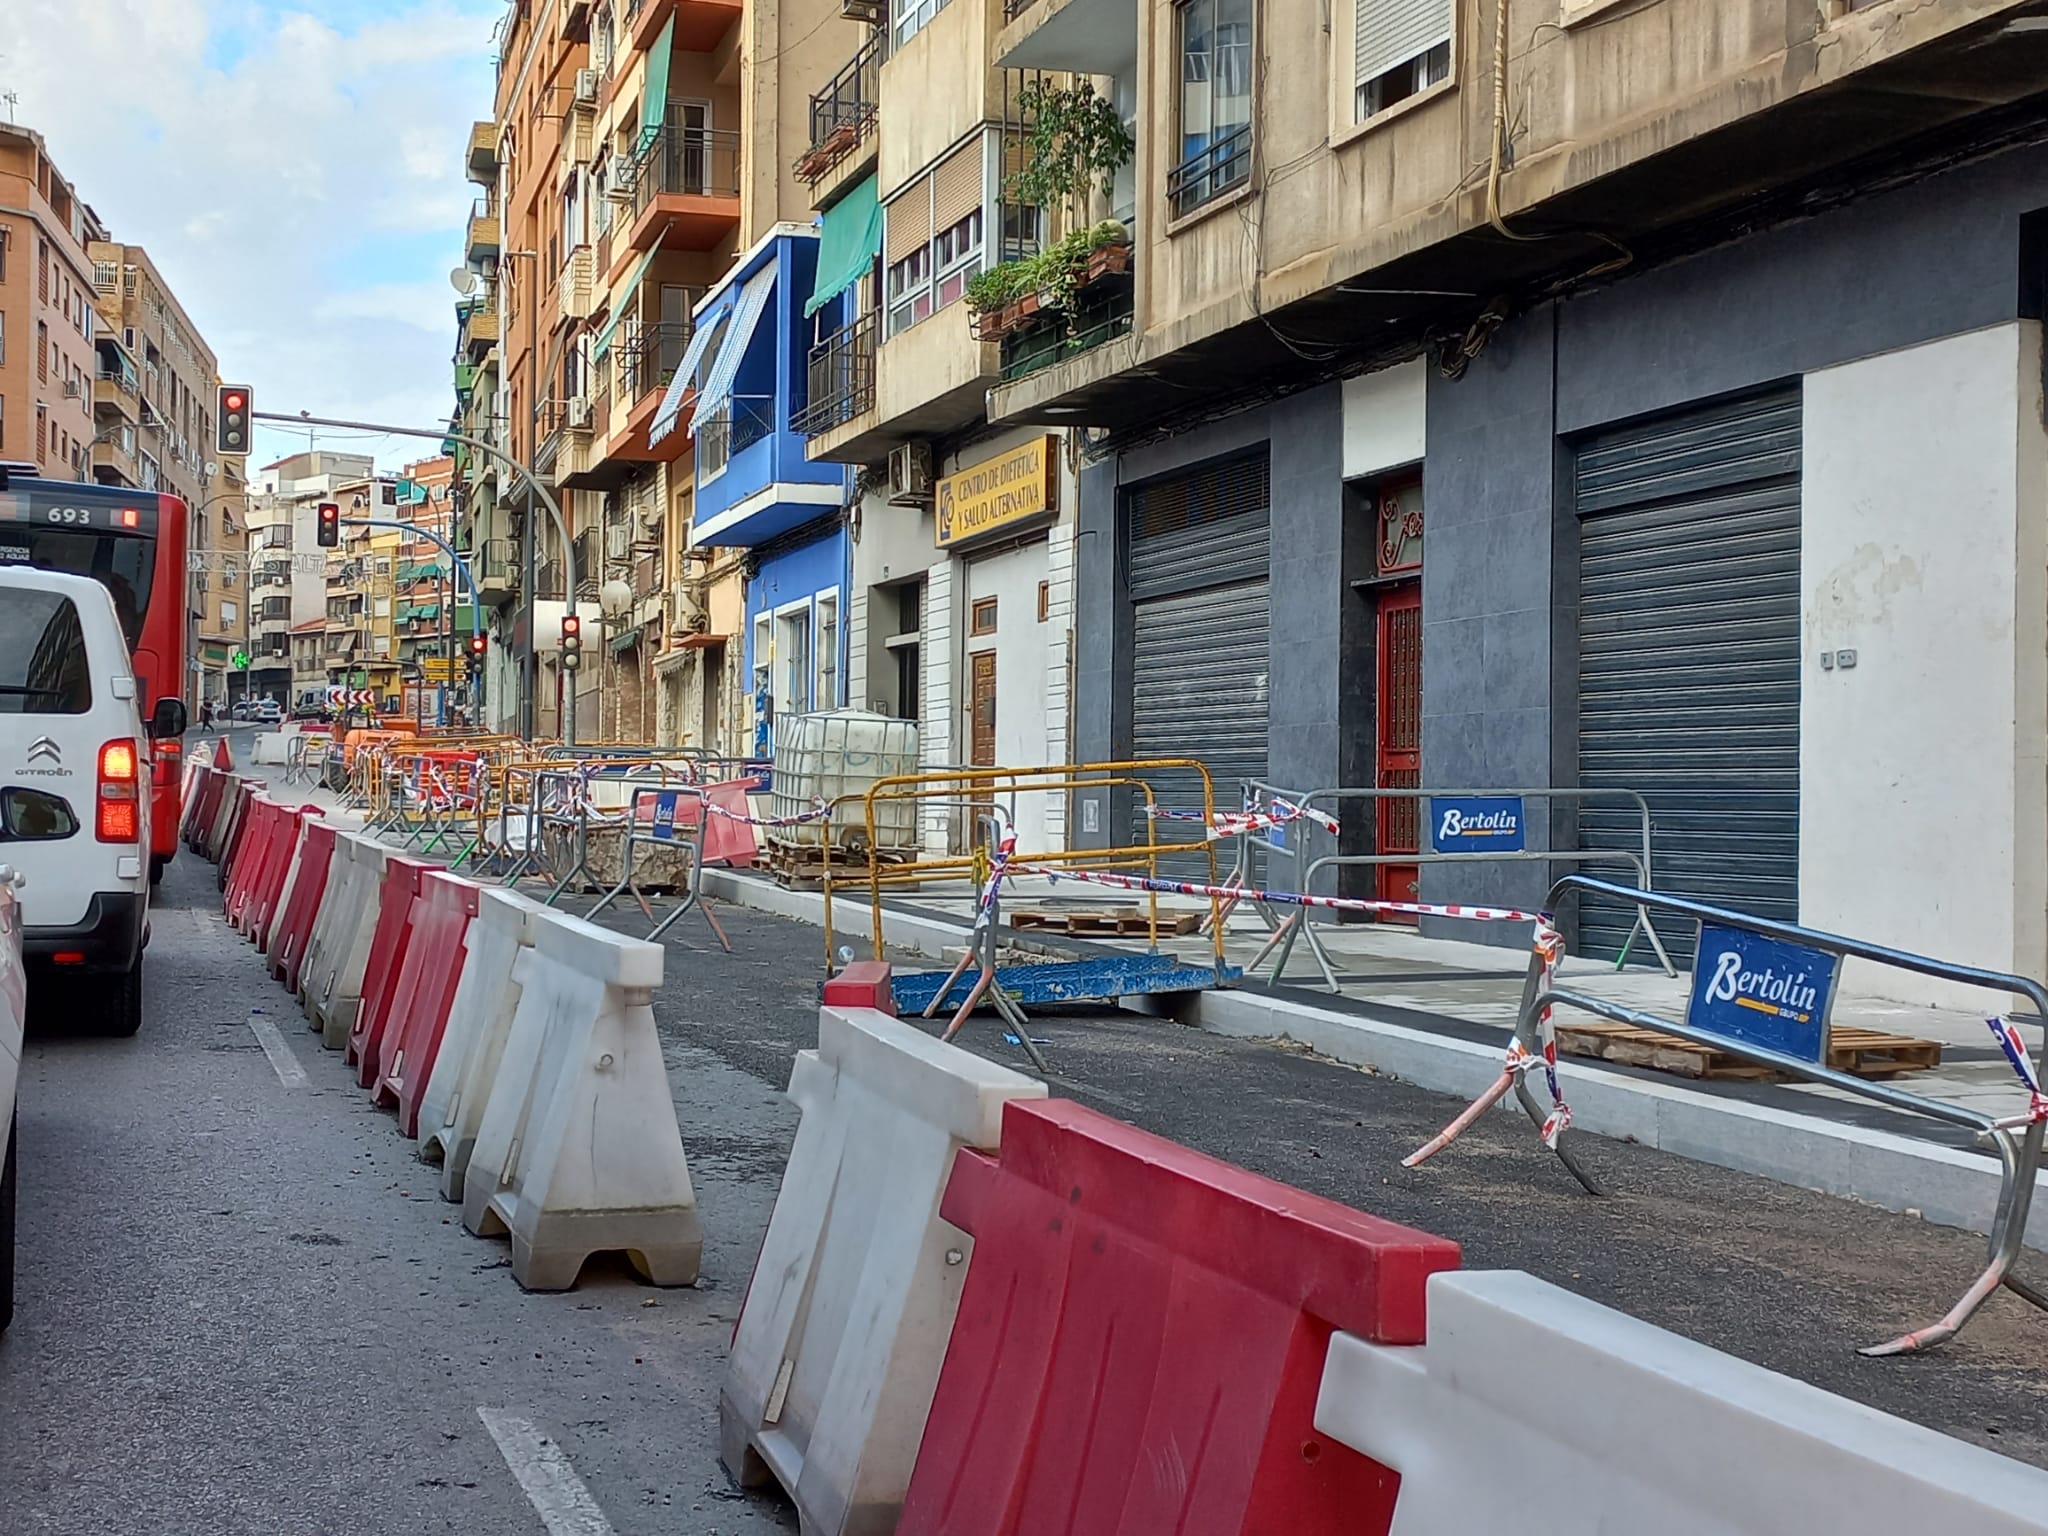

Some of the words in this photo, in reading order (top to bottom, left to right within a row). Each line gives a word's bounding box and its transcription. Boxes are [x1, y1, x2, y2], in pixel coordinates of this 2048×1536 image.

[959, 471, 988, 502] CENTRO
[988, 467, 999, 491] DE
[47, 507, 91, 525] 693
[957, 511, 963, 531] Y
[964, 502, 988, 530] SALUD
[989, 482, 1040, 519] ALTERNATIVA
